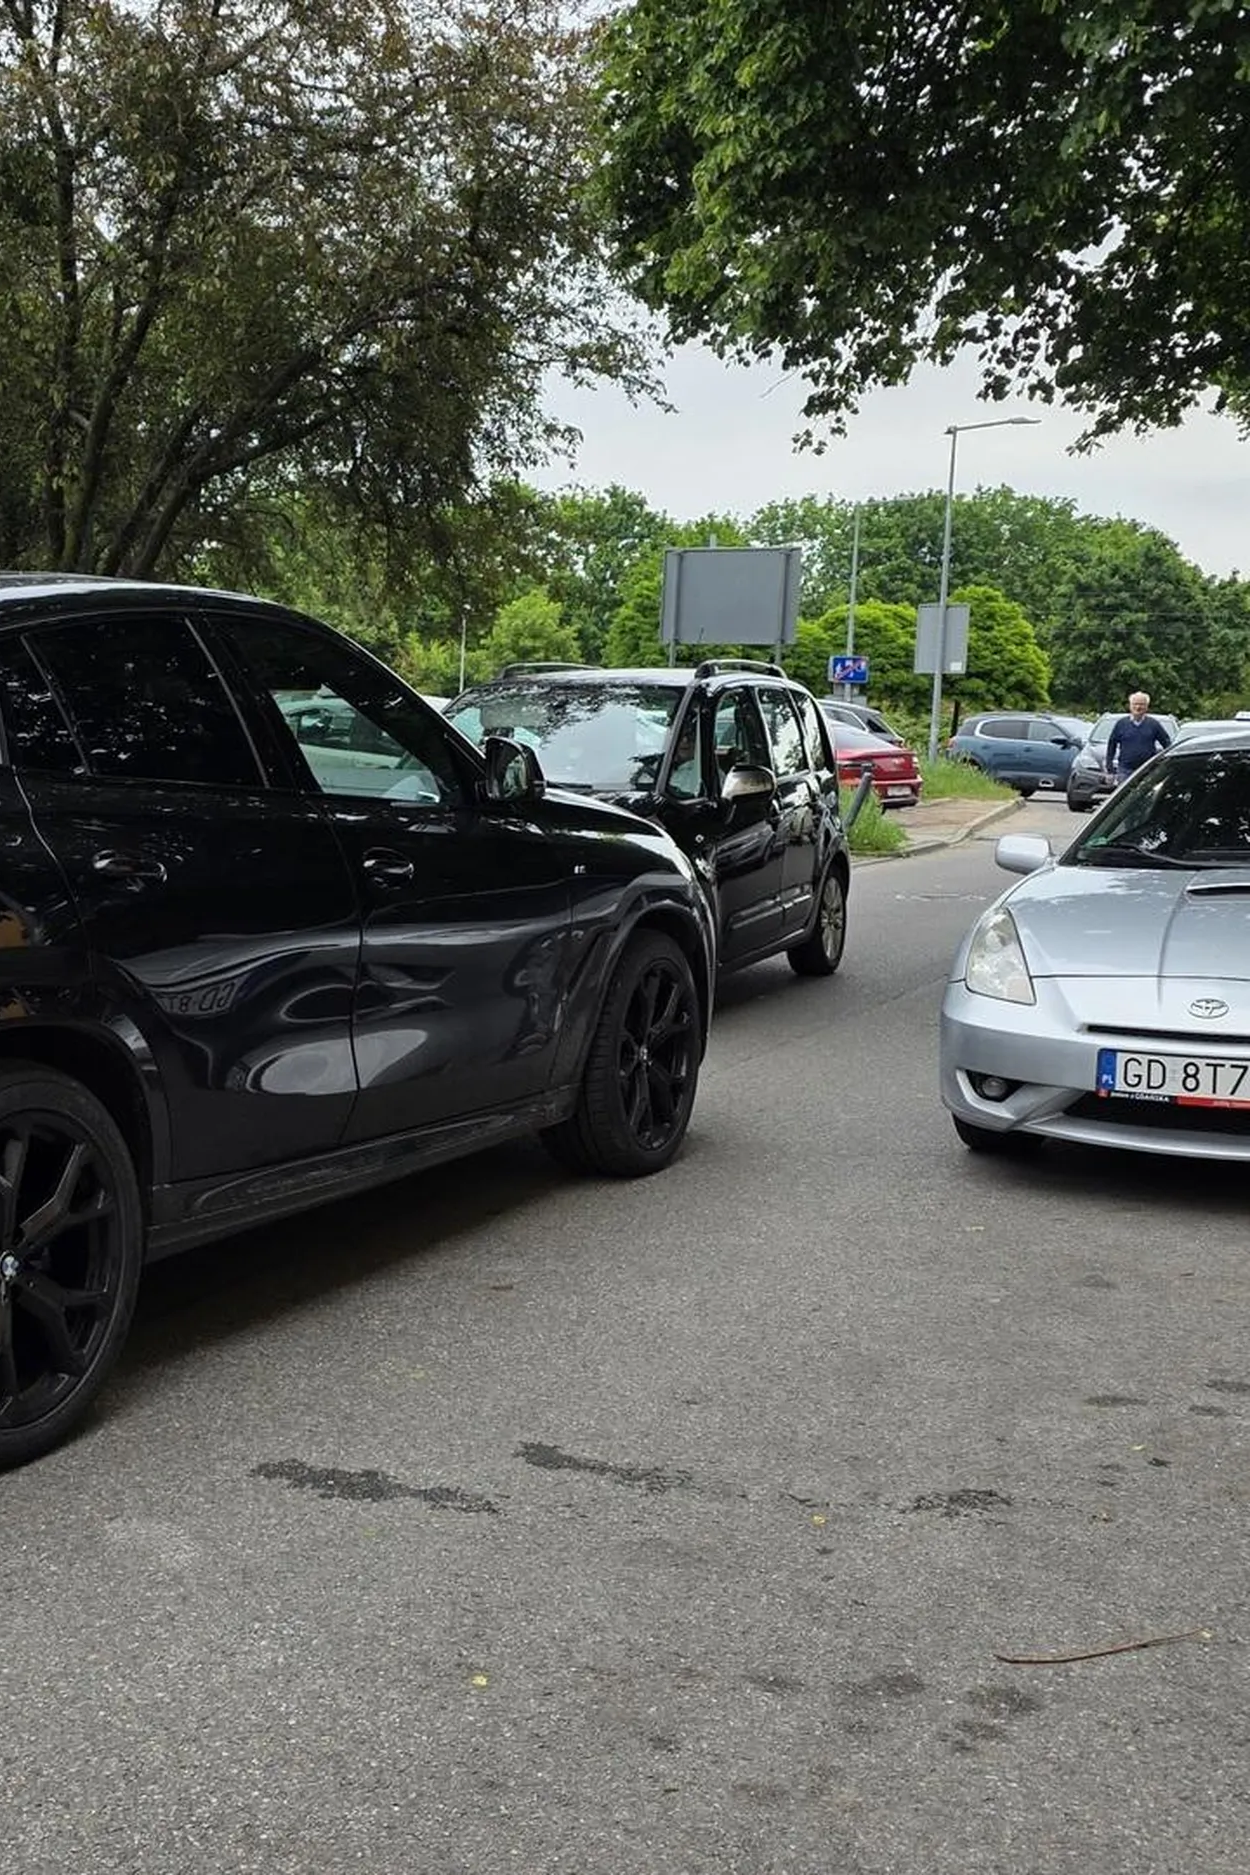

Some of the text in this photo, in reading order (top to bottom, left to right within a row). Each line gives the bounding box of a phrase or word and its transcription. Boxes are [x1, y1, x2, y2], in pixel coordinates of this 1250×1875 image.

[1102, 1074, 1114, 1085] PL
[1123, 1057, 1249, 1096] GD 8T7
